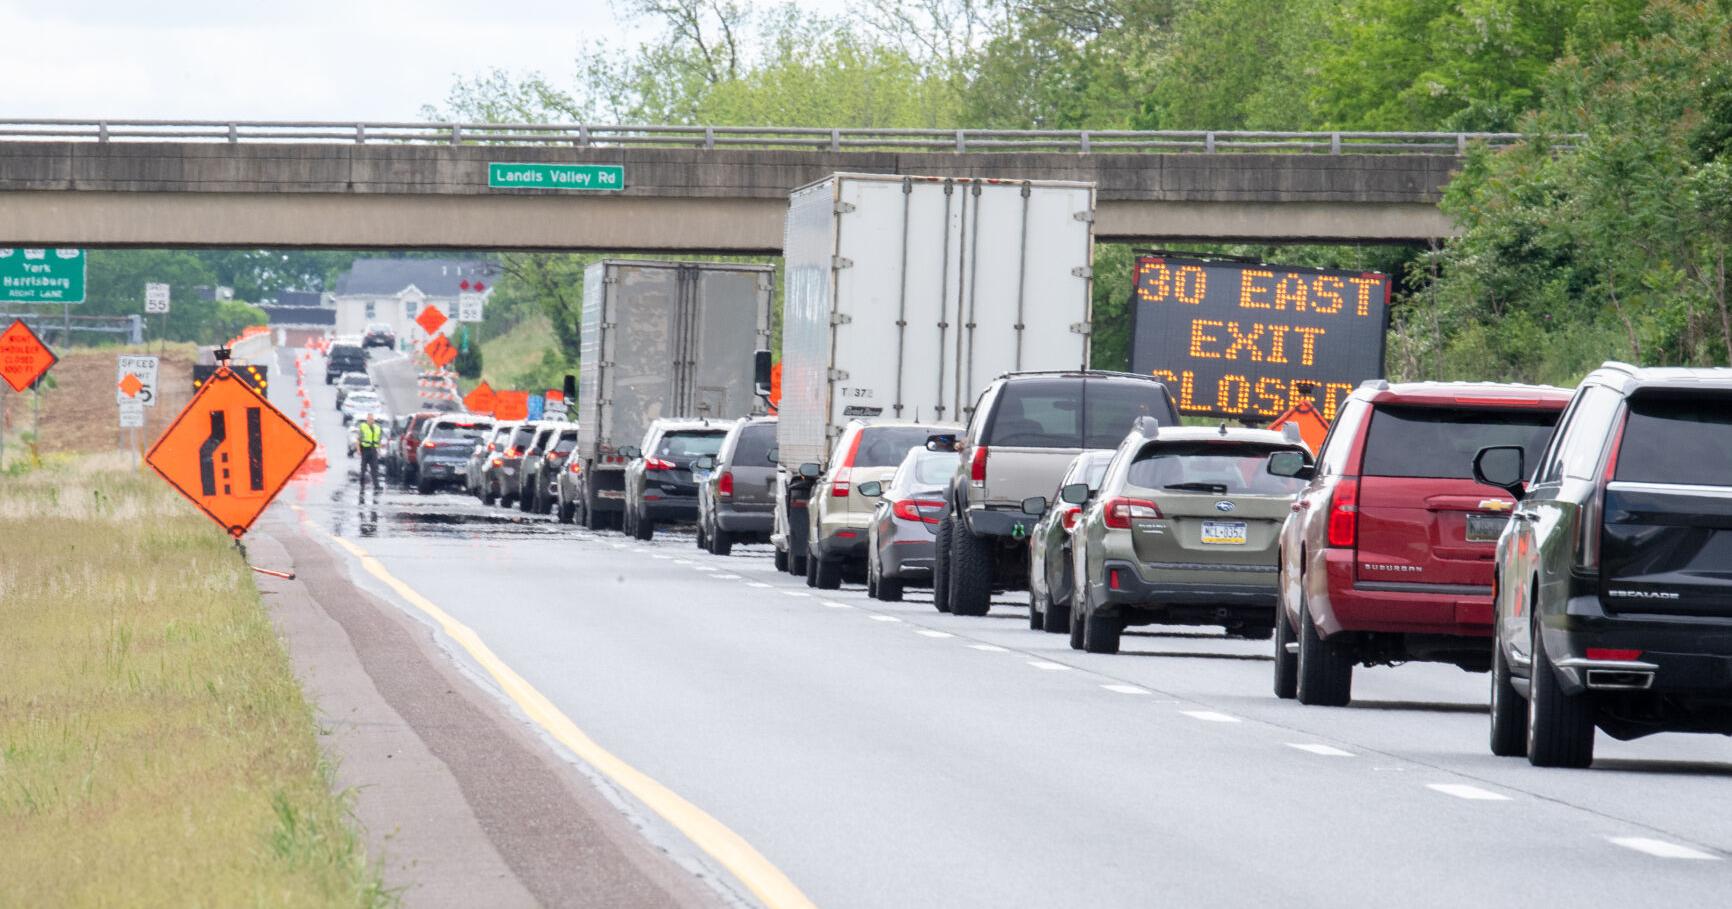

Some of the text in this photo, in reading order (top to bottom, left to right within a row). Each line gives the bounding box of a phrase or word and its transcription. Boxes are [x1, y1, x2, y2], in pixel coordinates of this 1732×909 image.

[496, 169, 616, 186] Landis Valley Rd
[23, 263, 51, 273] York
[3, 276, 70, 289] Harrisburg
[40, 290, 63, 298] LANE
[1138, 263, 1381, 316] 30 EAST
[148, 299, 166, 310] 55
[1190, 319, 1325, 366] EXIT
[121, 359, 155, 368] SPEED
[1364, 563, 1423, 572] SUBURBAN
[1609, 589, 1680, 599] ESCALADE
